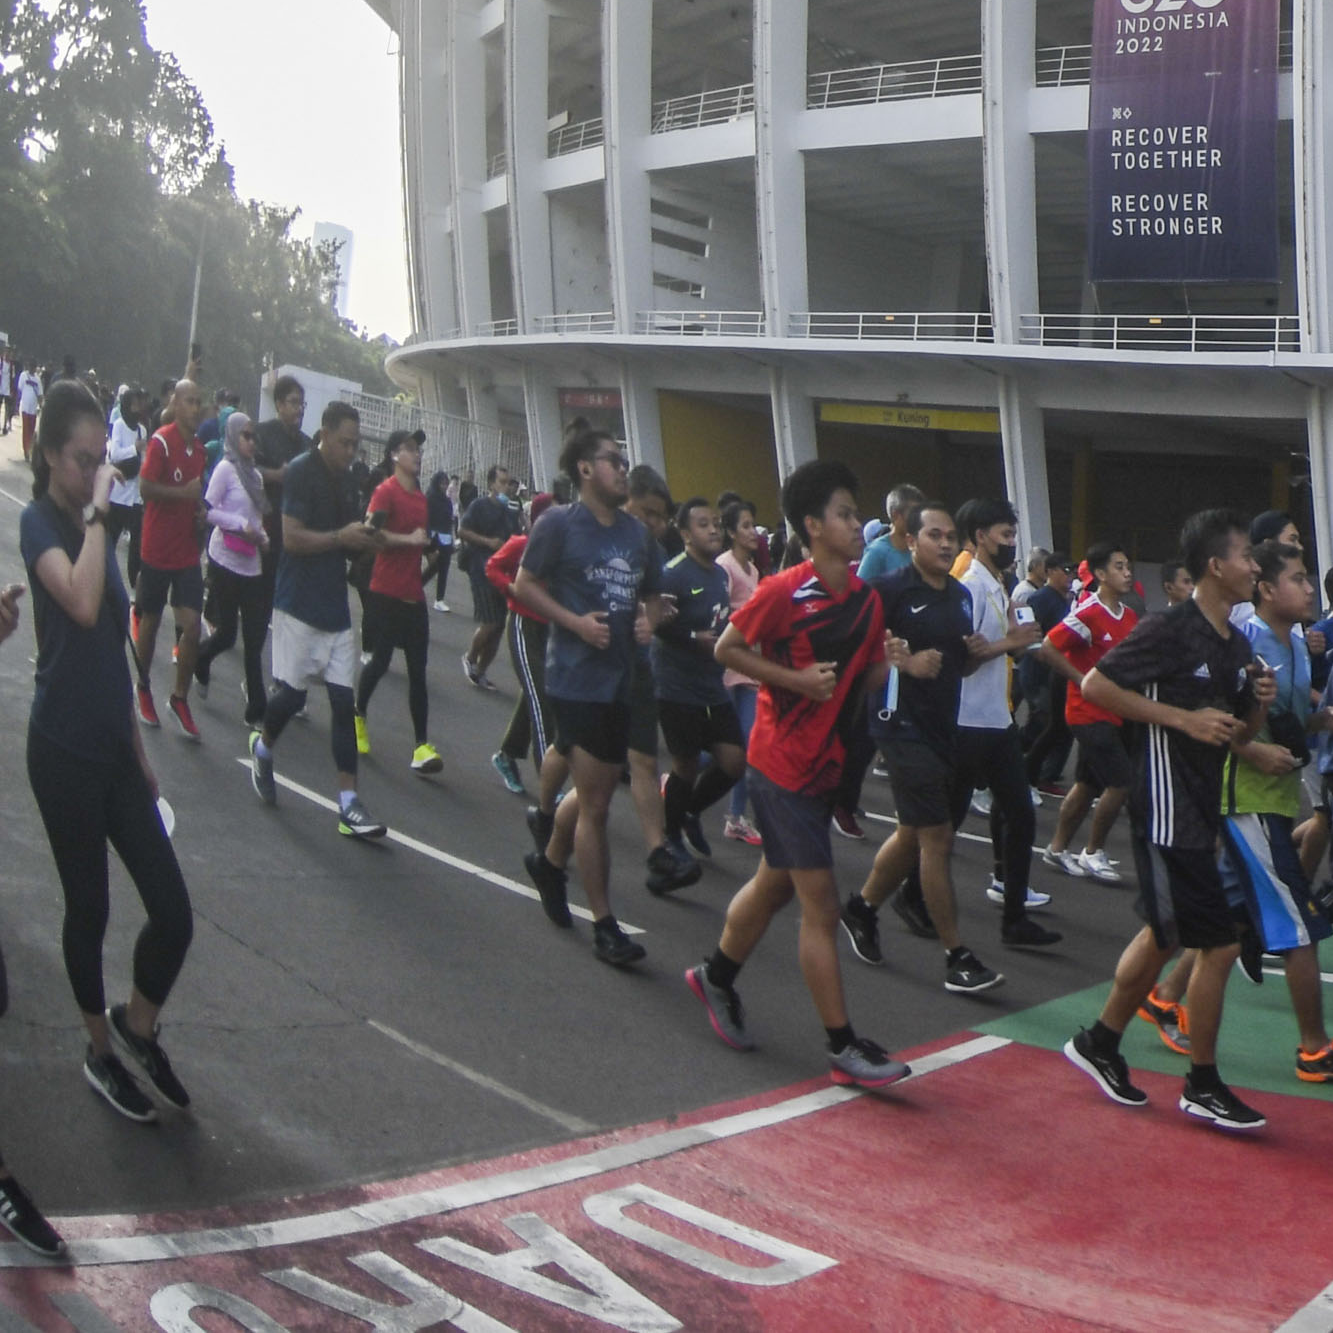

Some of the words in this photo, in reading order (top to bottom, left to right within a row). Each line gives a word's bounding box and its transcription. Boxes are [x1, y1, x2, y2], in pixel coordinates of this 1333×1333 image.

[1116, 10, 1230, 35] INDONESIA
[1114, 36, 1165, 55] 2022
[1110, 125, 1209, 148] RECOVER
[1110, 149, 1223, 171] TOGETHER
[1110, 192, 1210, 213] RECOVER
[1110, 216, 1224, 237] STRONGER
